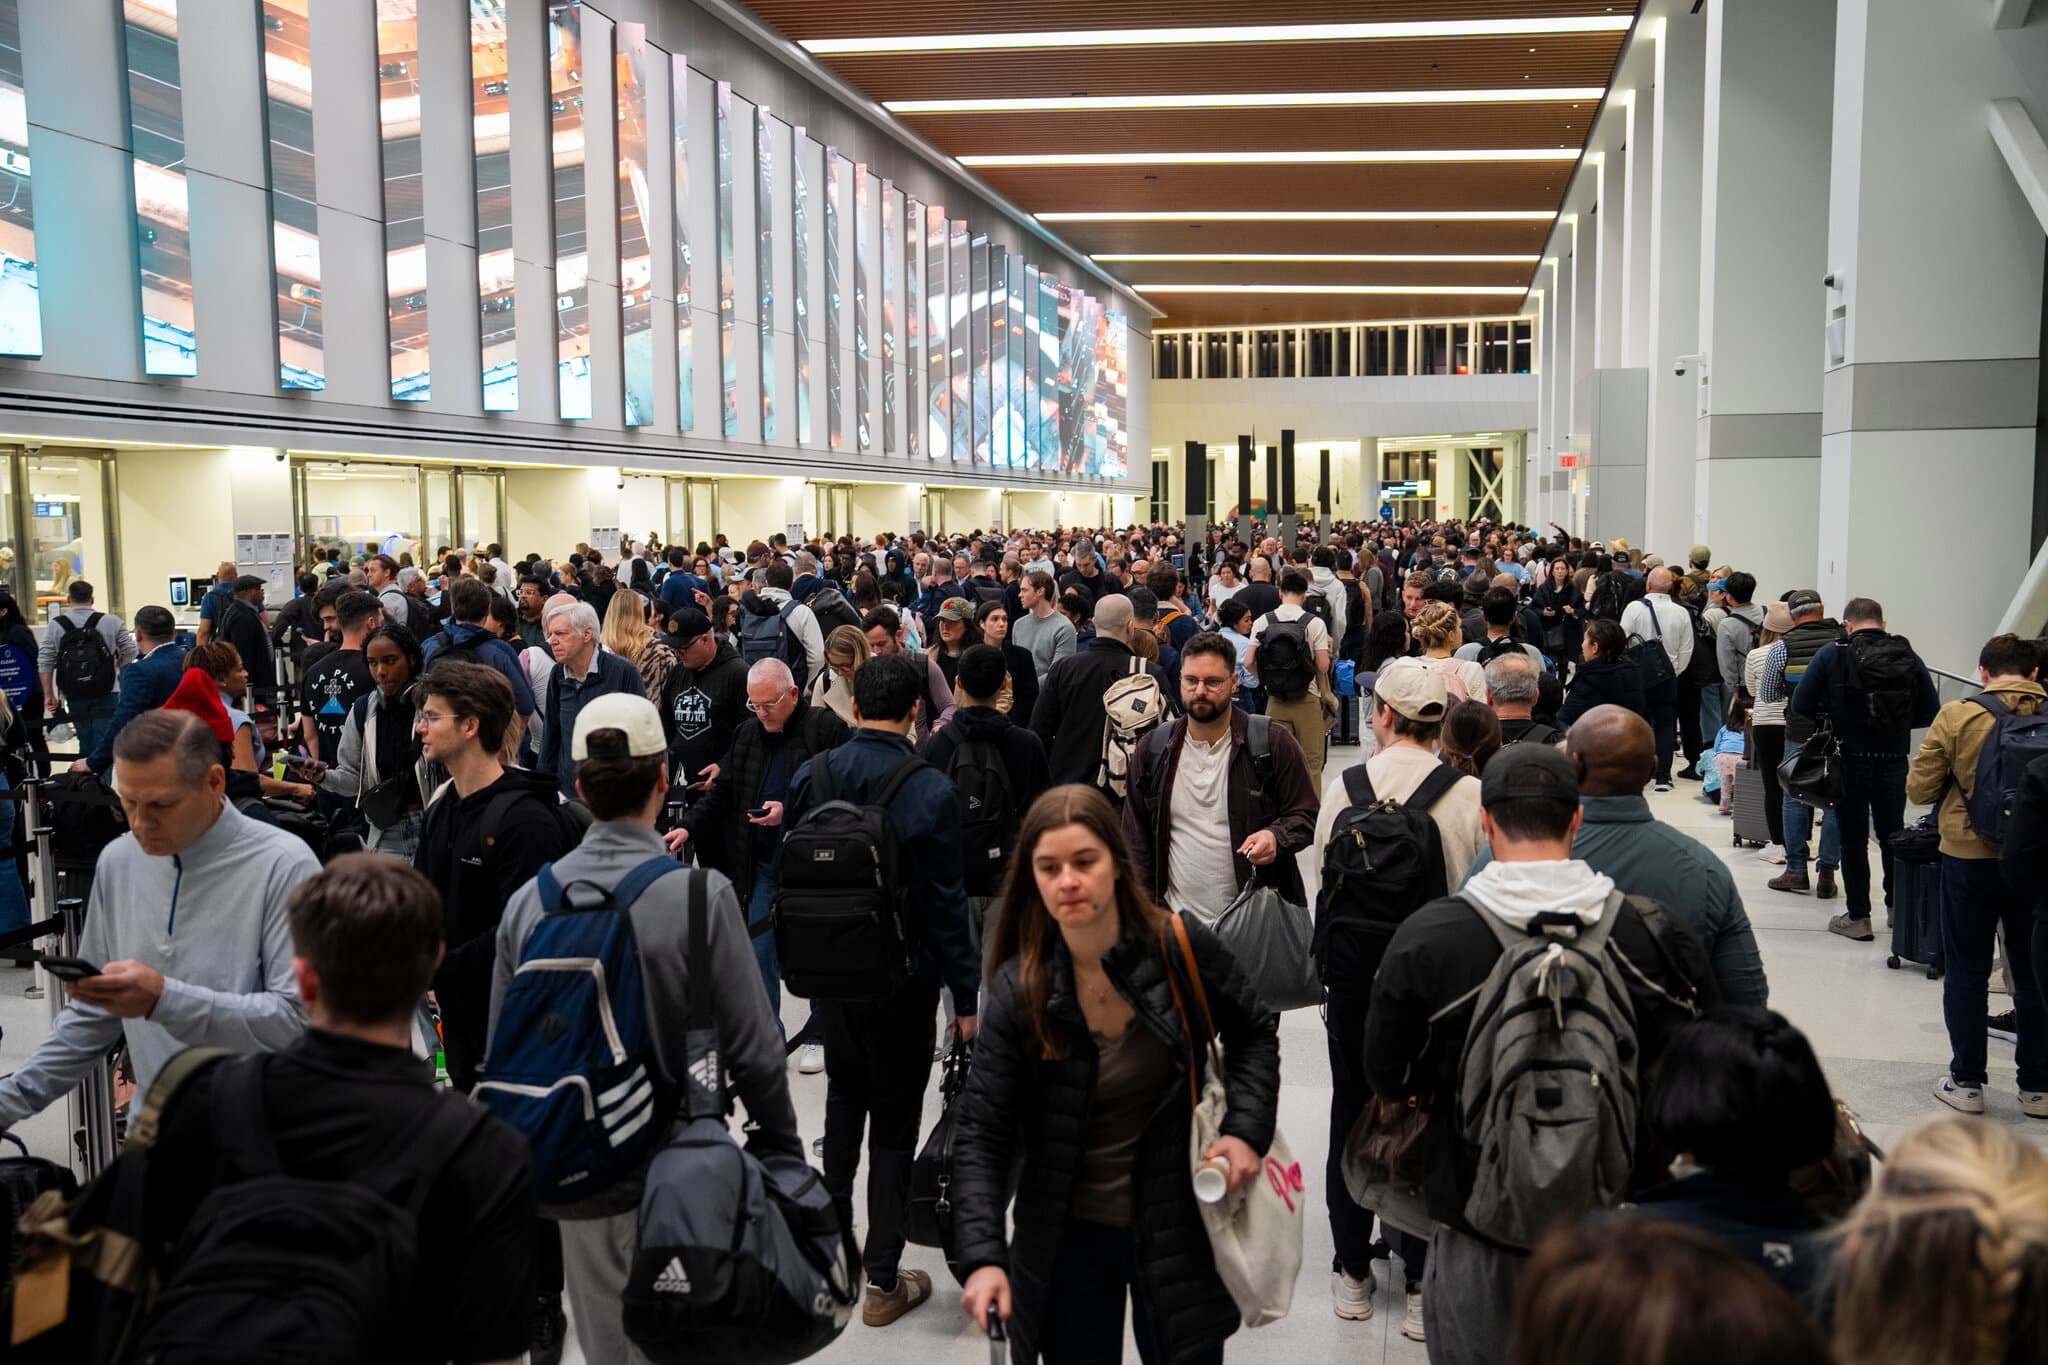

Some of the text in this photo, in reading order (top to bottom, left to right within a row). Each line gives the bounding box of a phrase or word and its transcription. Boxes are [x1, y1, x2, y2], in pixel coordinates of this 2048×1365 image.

[1560, 455, 1578, 467] EXIT
[311, 669, 355, 690] LA PAZ
[653, 1279, 691, 1293] adidas
